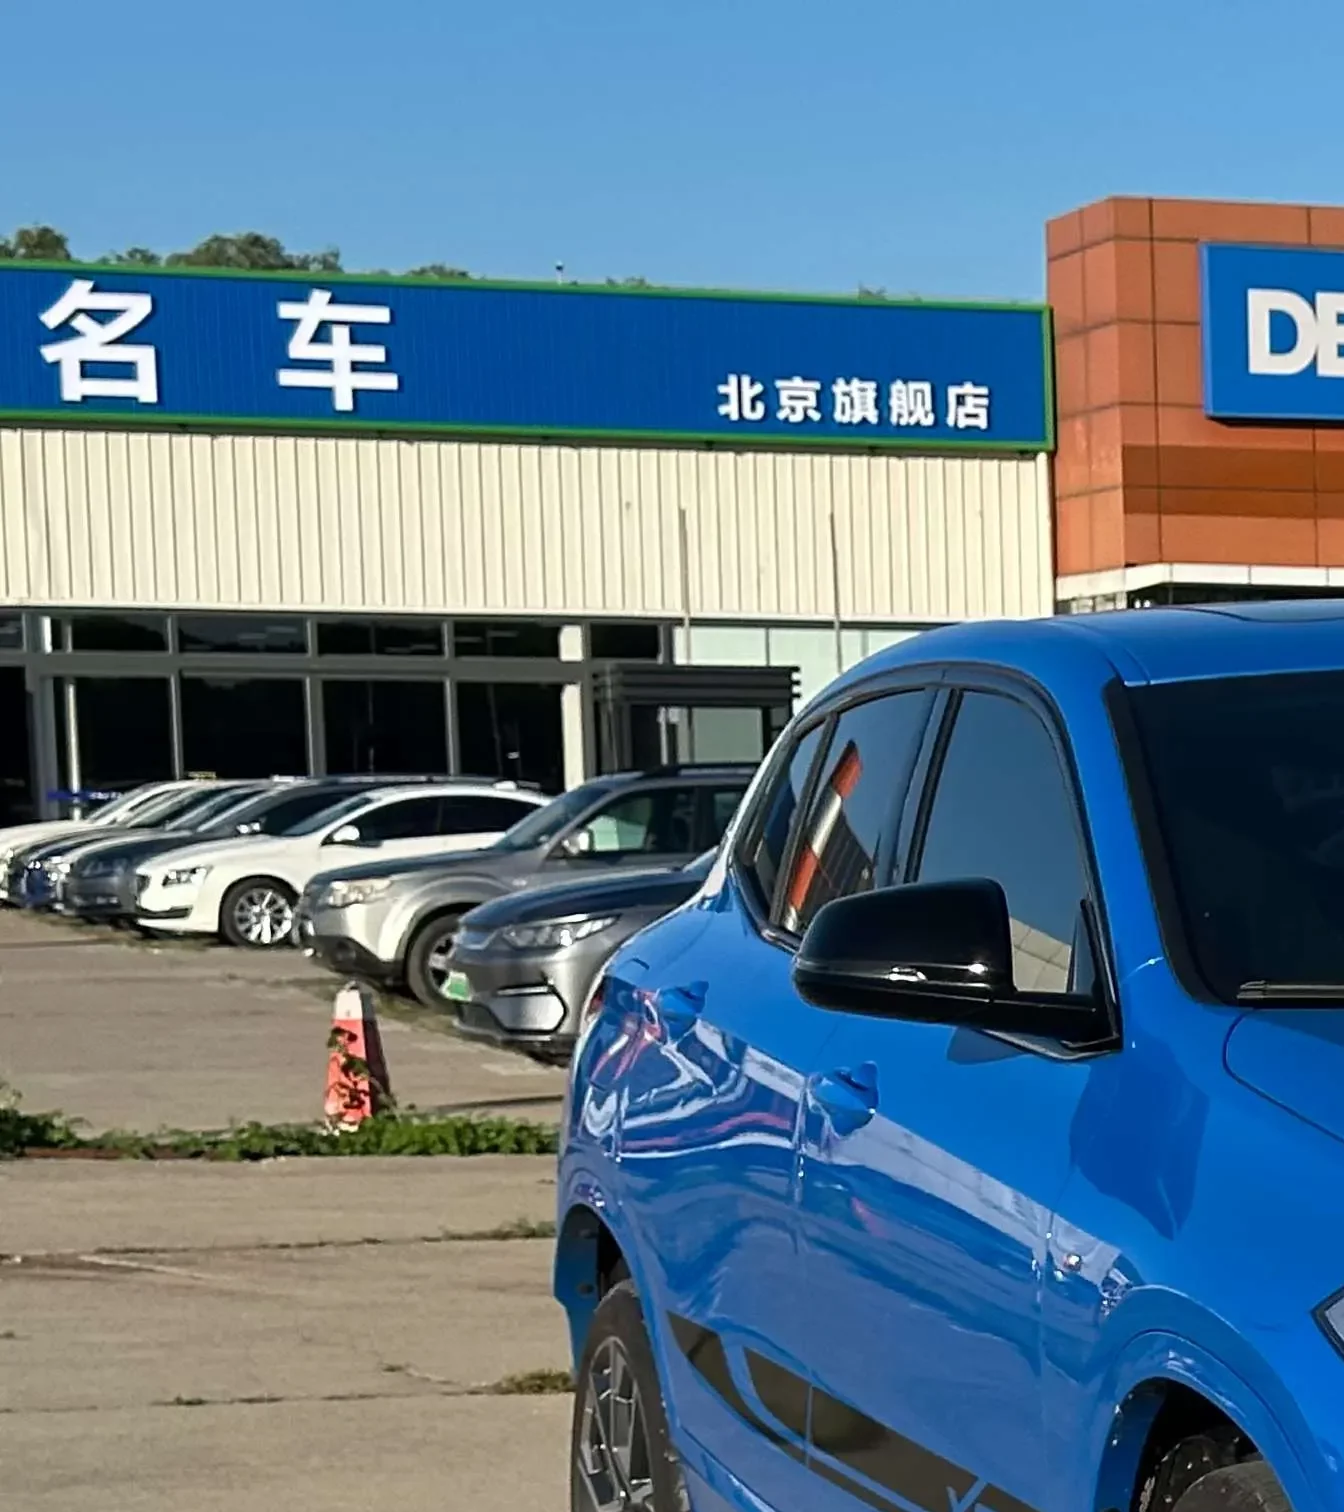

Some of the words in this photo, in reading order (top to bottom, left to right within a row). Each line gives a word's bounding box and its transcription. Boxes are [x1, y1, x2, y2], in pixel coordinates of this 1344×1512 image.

[38, 279, 399, 411] 名车
[716, 374, 990, 430] 北京旗舰店
